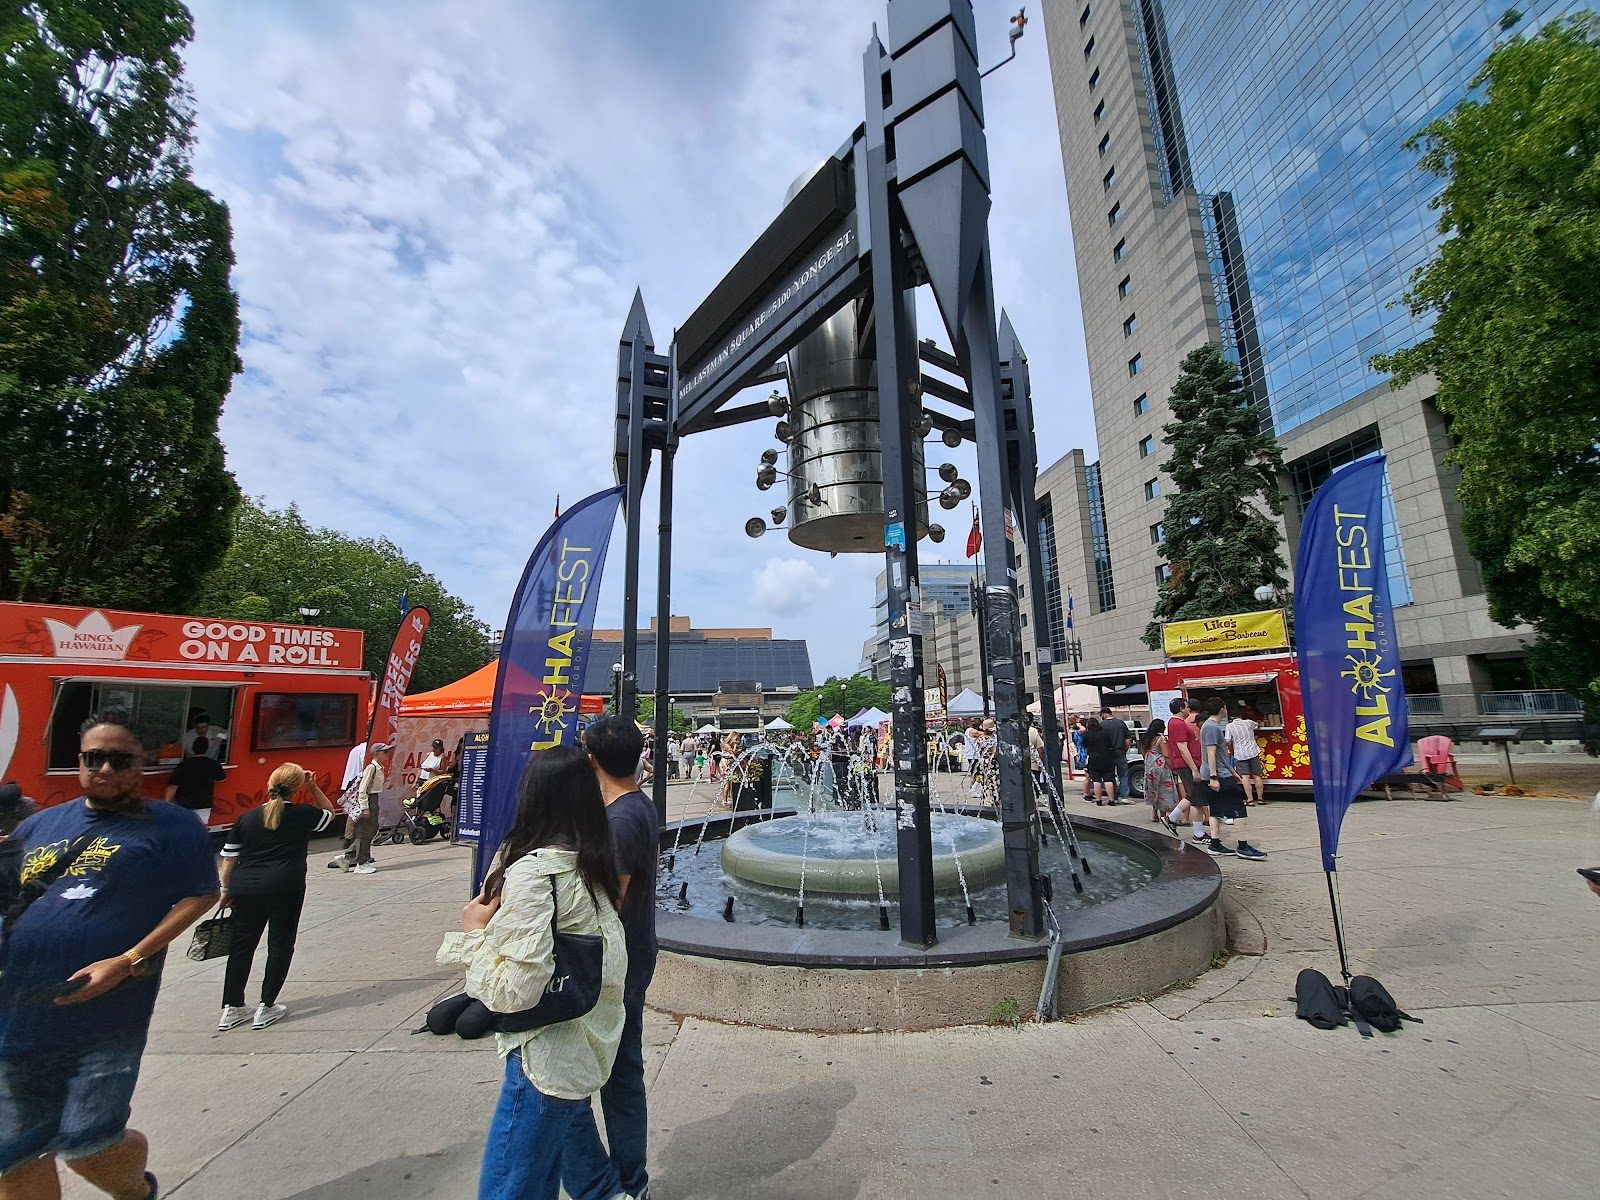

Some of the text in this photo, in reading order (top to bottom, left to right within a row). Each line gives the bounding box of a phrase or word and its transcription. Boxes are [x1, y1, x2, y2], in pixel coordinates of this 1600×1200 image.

[680, 229, 856, 399] MEL LASTMAN SQUARE 5100 YONGE ST.
[182, 621, 340, 647] GOOD TIMES.
[1203, 618, 1238, 632] Liko's
[1374, 594, 1390, 653] TORONTO
[60, 641, 124, 652] HAWAIIAN
[1179, 629, 1269, 646] Hawaiian Barbecue
[179, 639, 339, 666] ON A ROLL.
[571, 629, 586, 690] TORONTO
[380, 652, 402, 709] FREE
